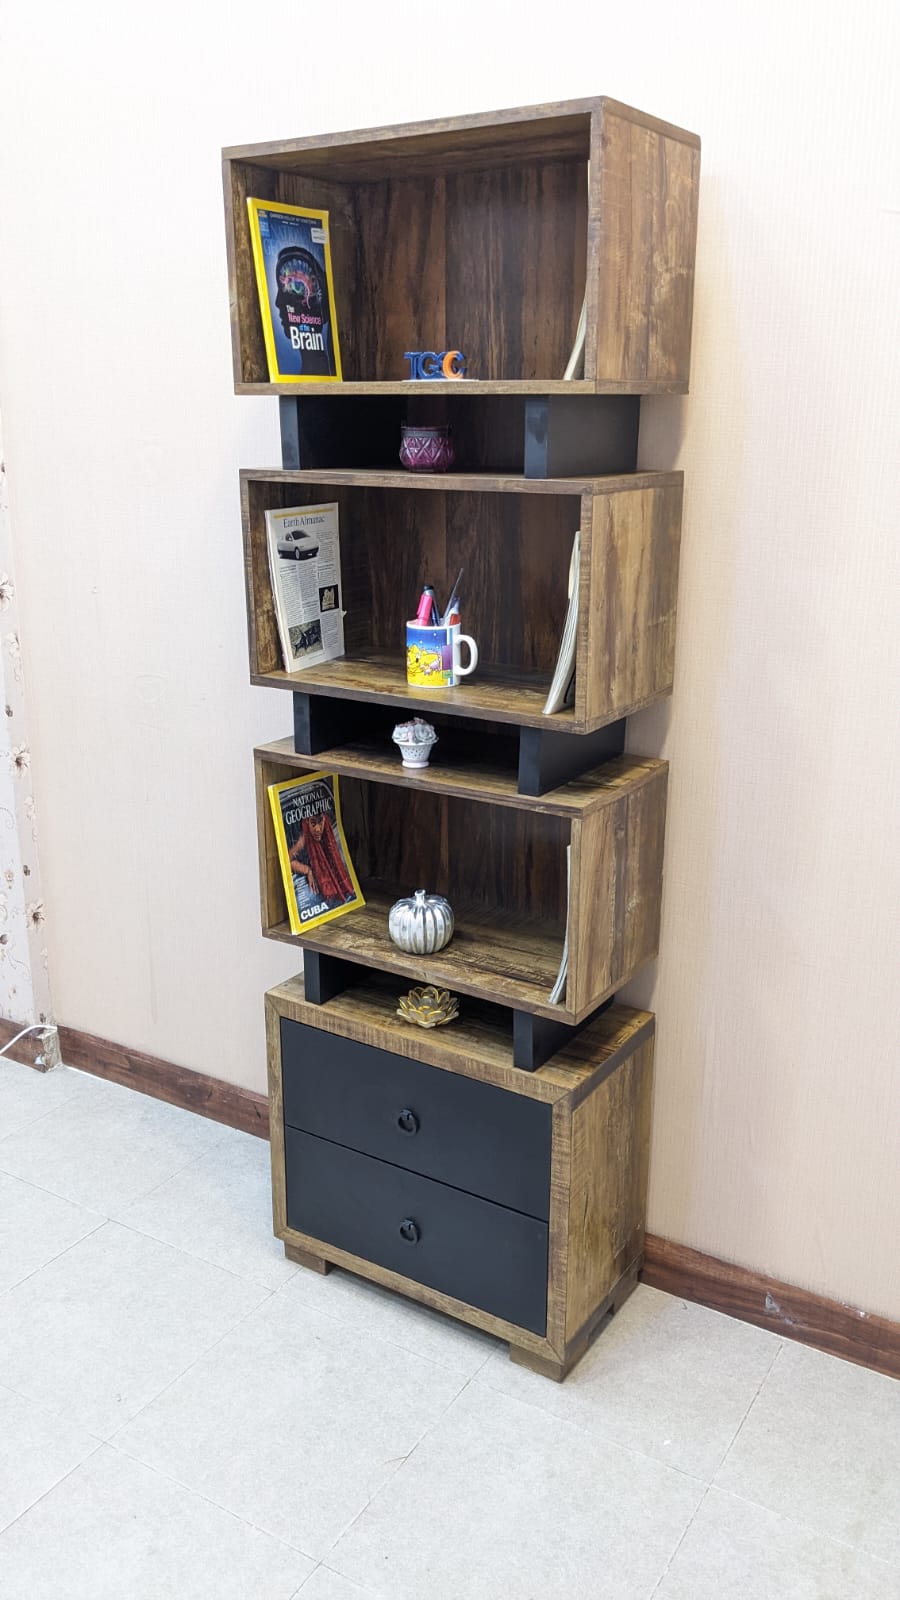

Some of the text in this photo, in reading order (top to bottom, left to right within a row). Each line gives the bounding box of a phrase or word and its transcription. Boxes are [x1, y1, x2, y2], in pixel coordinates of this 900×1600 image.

[288, 313, 321, 325] New Science
[290, 326, 324, 351] Brain
[283, 517, 299, 528] Earth
[292, 789, 325, 807] NATIONAL
[285, 797, 332, 825] GEOGRAPHIC
[300, 902, 329, 920] CUBA
